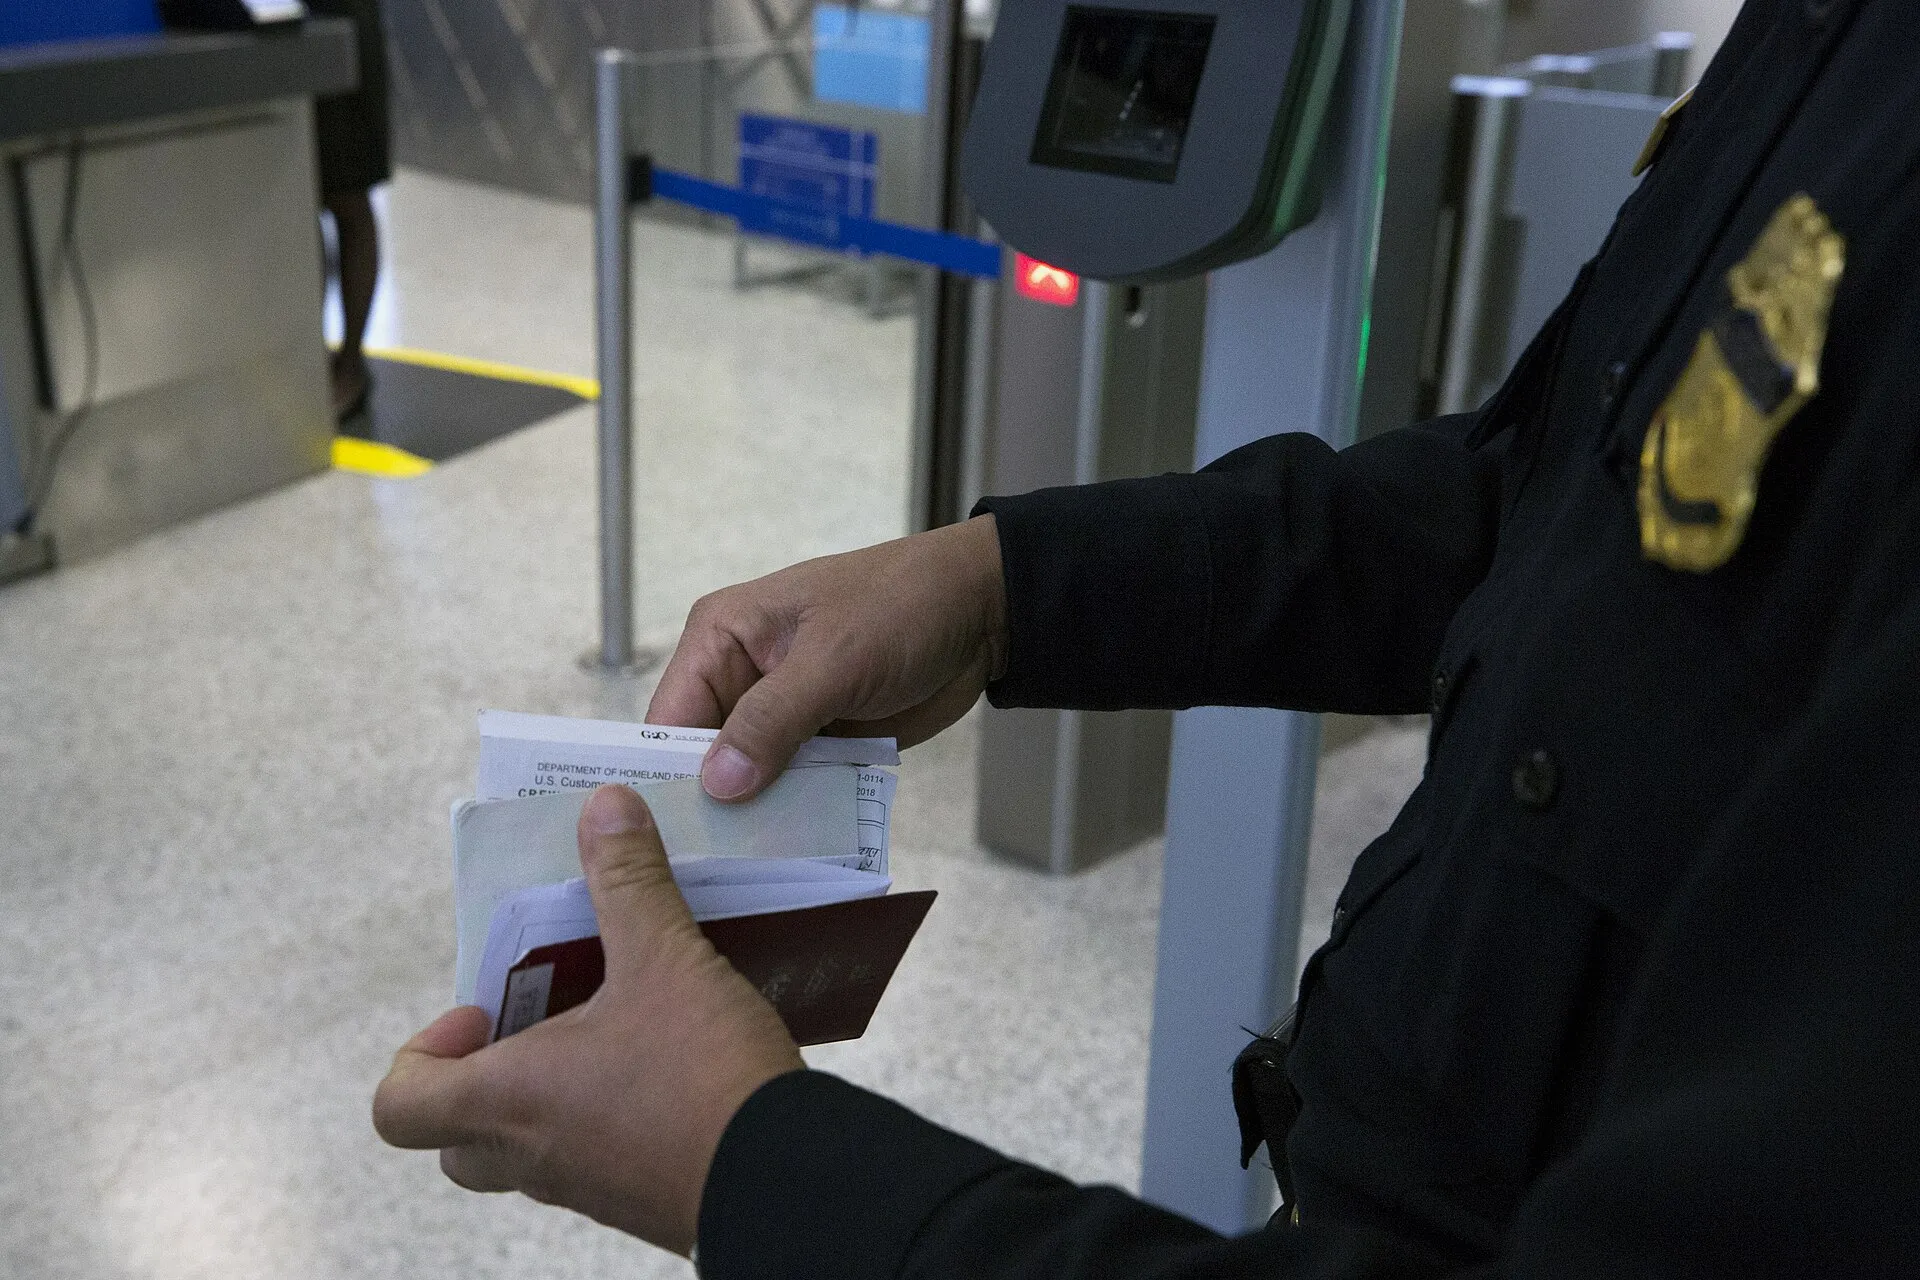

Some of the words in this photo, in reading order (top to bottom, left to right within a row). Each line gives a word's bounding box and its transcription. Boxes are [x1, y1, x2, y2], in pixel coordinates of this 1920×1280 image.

[537, 762, 601, 775] DEPARTMENT
[604, 767, 617, 777] OF
[620, 769, 671, 781] HOMELAND
[856, 787, 876, 797] 2018
